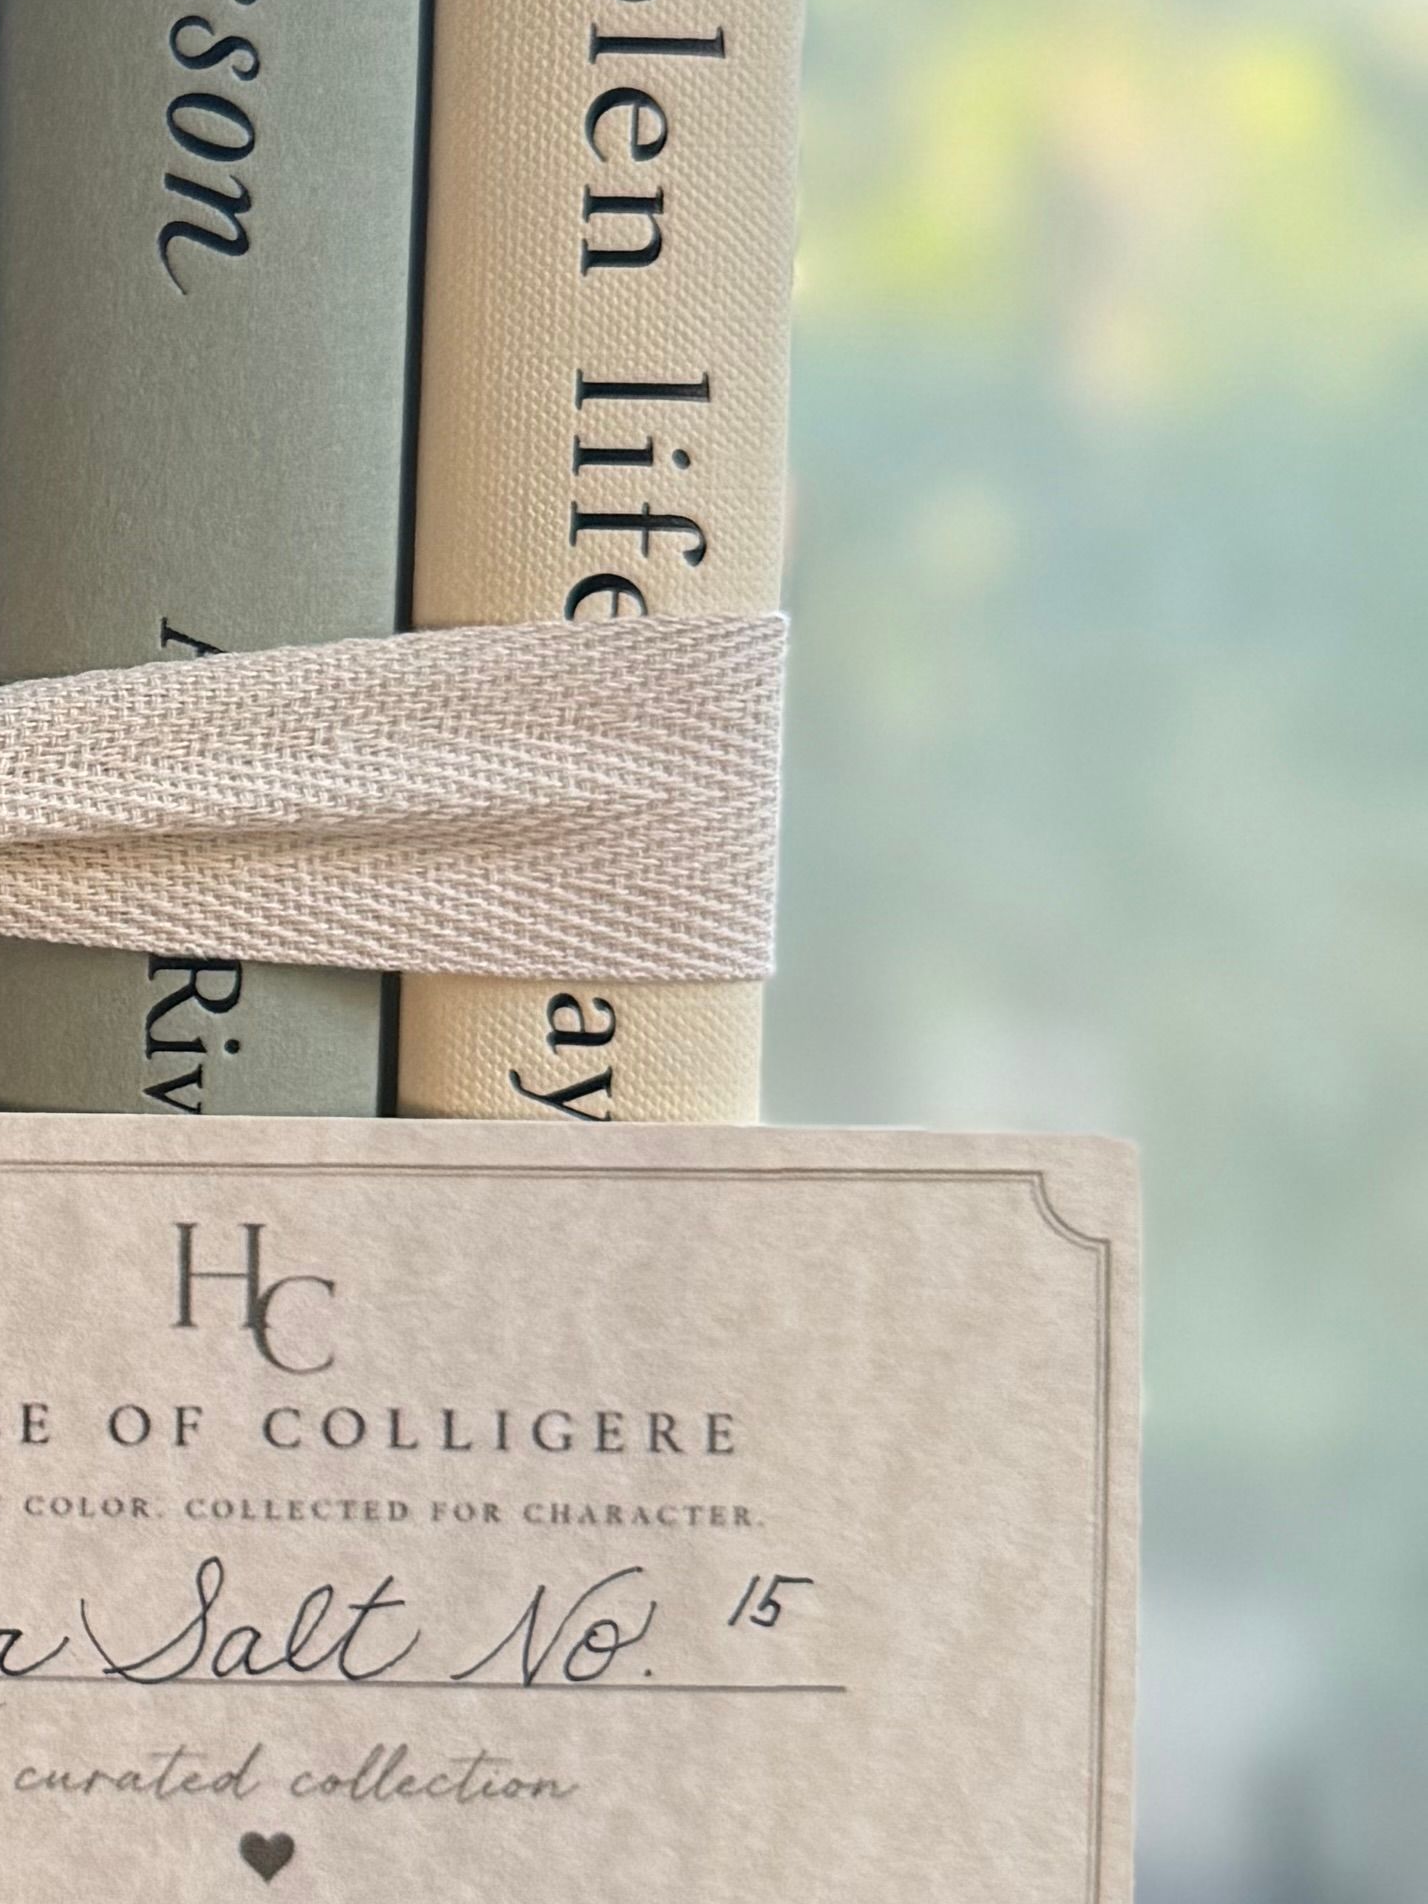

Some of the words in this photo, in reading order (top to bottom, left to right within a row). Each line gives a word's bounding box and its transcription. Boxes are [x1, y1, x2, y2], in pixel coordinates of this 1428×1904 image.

[565, 367, 712, 620] life
[108, 1404, 204, 1449] OF
[262, 1407, 737, 1455] COLLIGERE
[24, 1496, 164, 1519] COLOR.
[185, 1499, 410, 1523] COLLECTED
[430, 1502, 503, 1524] FOR
[523, 1504, 765, 1529] CHARACTER.
[79, 1555, 421, 1685] Salt
[727, 1573, 815, 1629] 15
[12, 1743, 263, 1801] curated
[289, 1743, 582, 1805] collection
